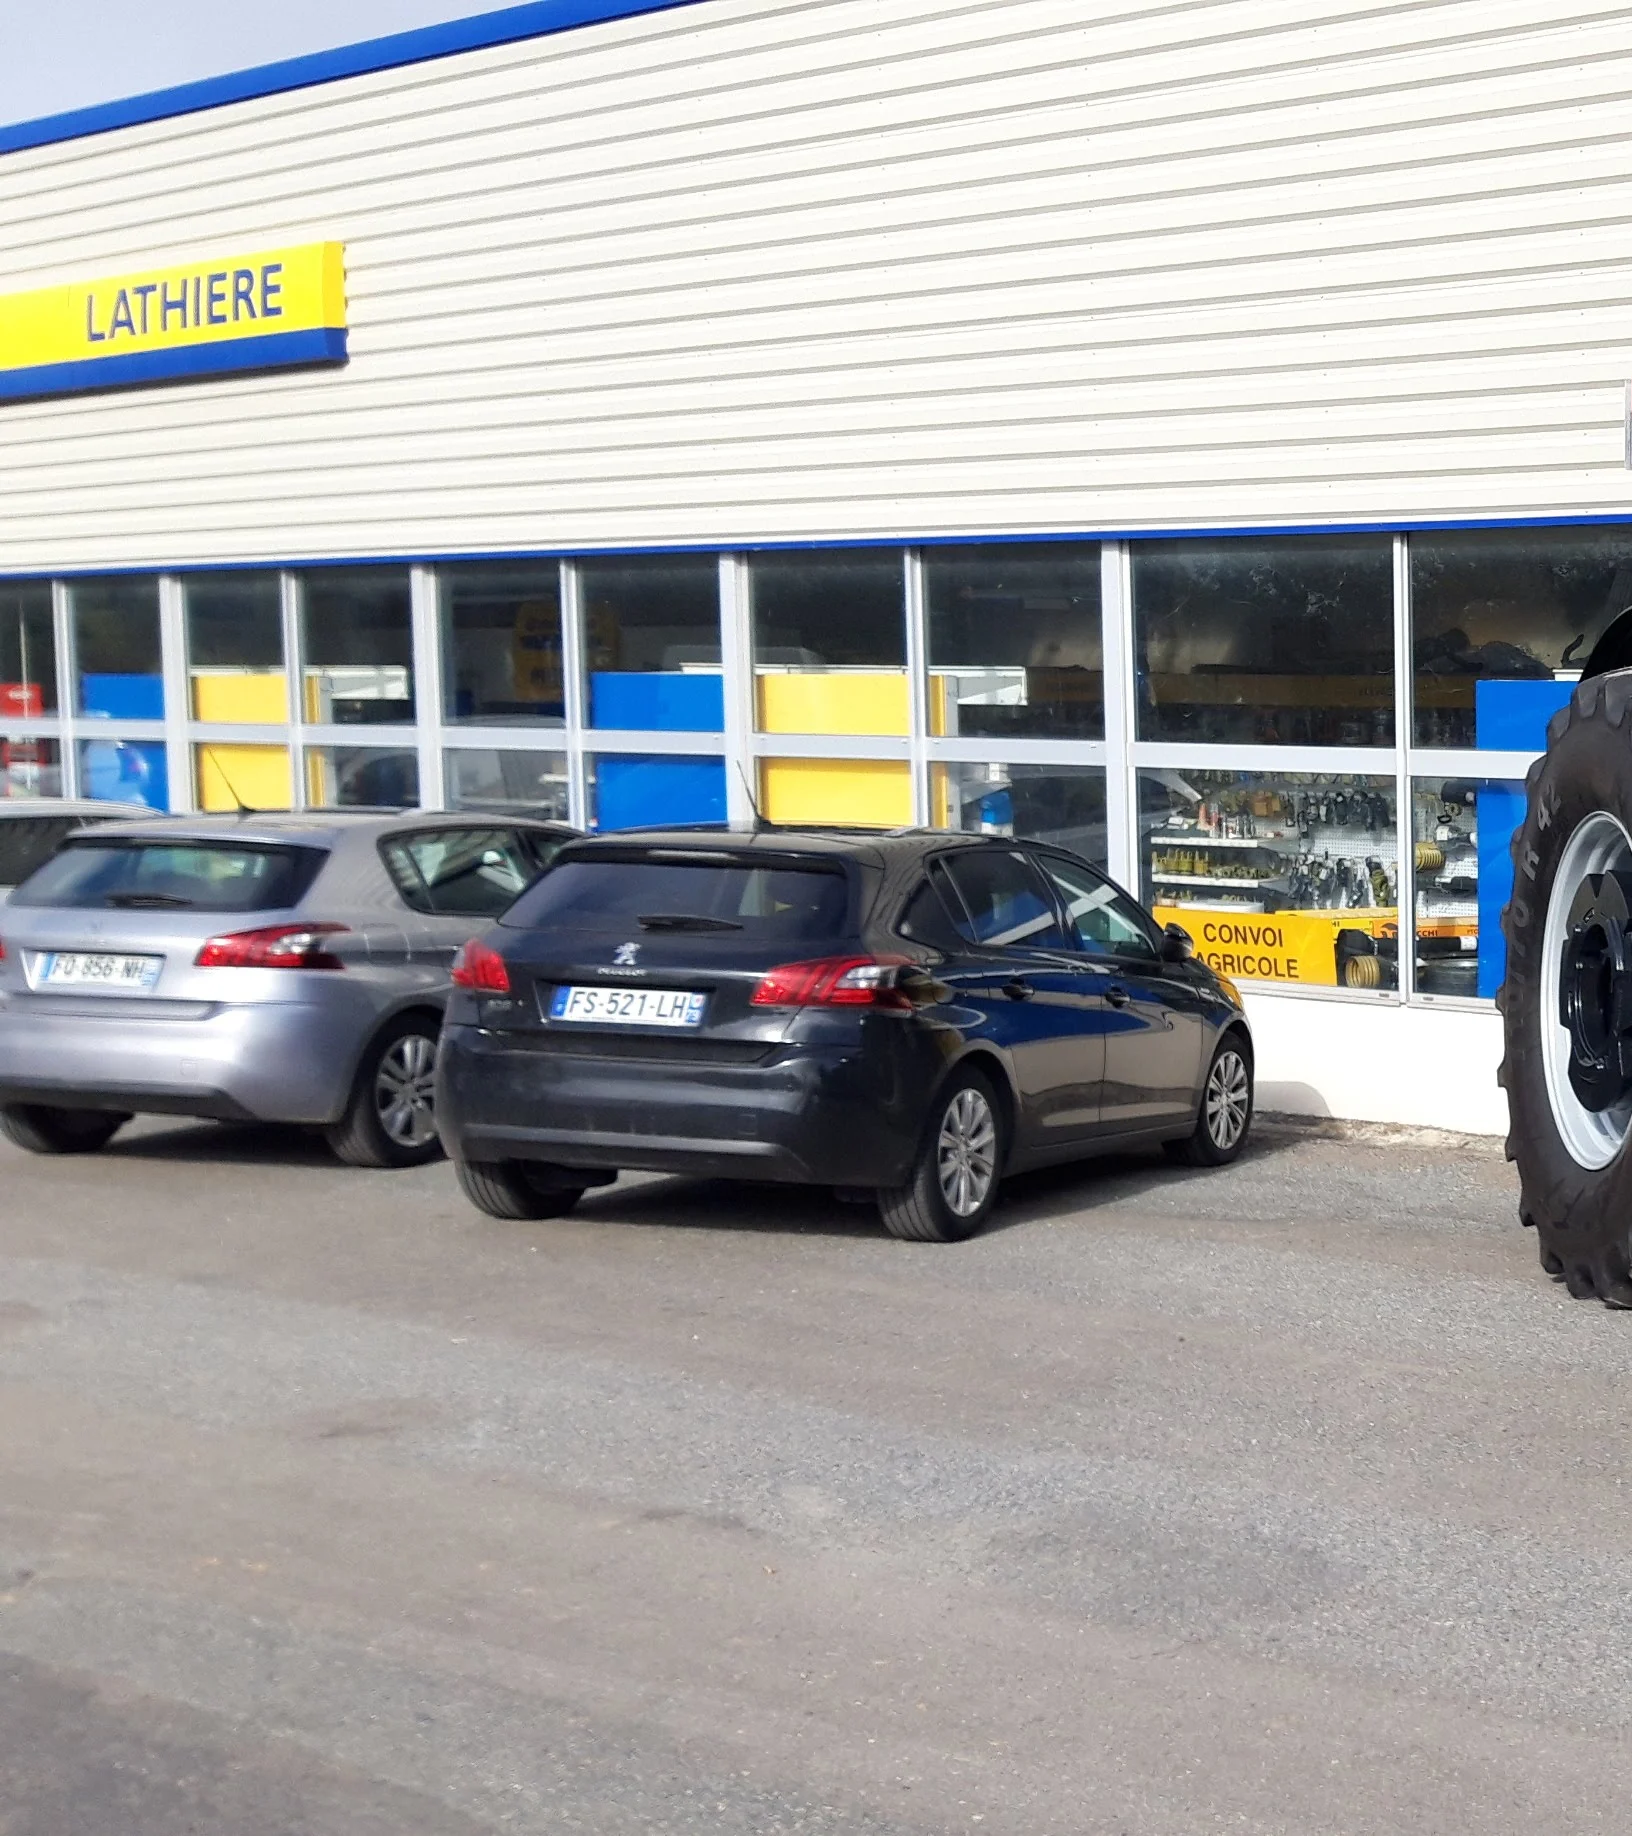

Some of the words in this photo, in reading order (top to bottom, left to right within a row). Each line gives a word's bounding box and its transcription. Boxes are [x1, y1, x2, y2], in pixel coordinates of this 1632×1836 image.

[86, 263, 283, 342] LATHIERE
[1203, 923, 1283, 948] CONVOI
[1196, 951, 1299, 979] AGRICOLE
[568, 990, 688, 1019] FS-521-LH
